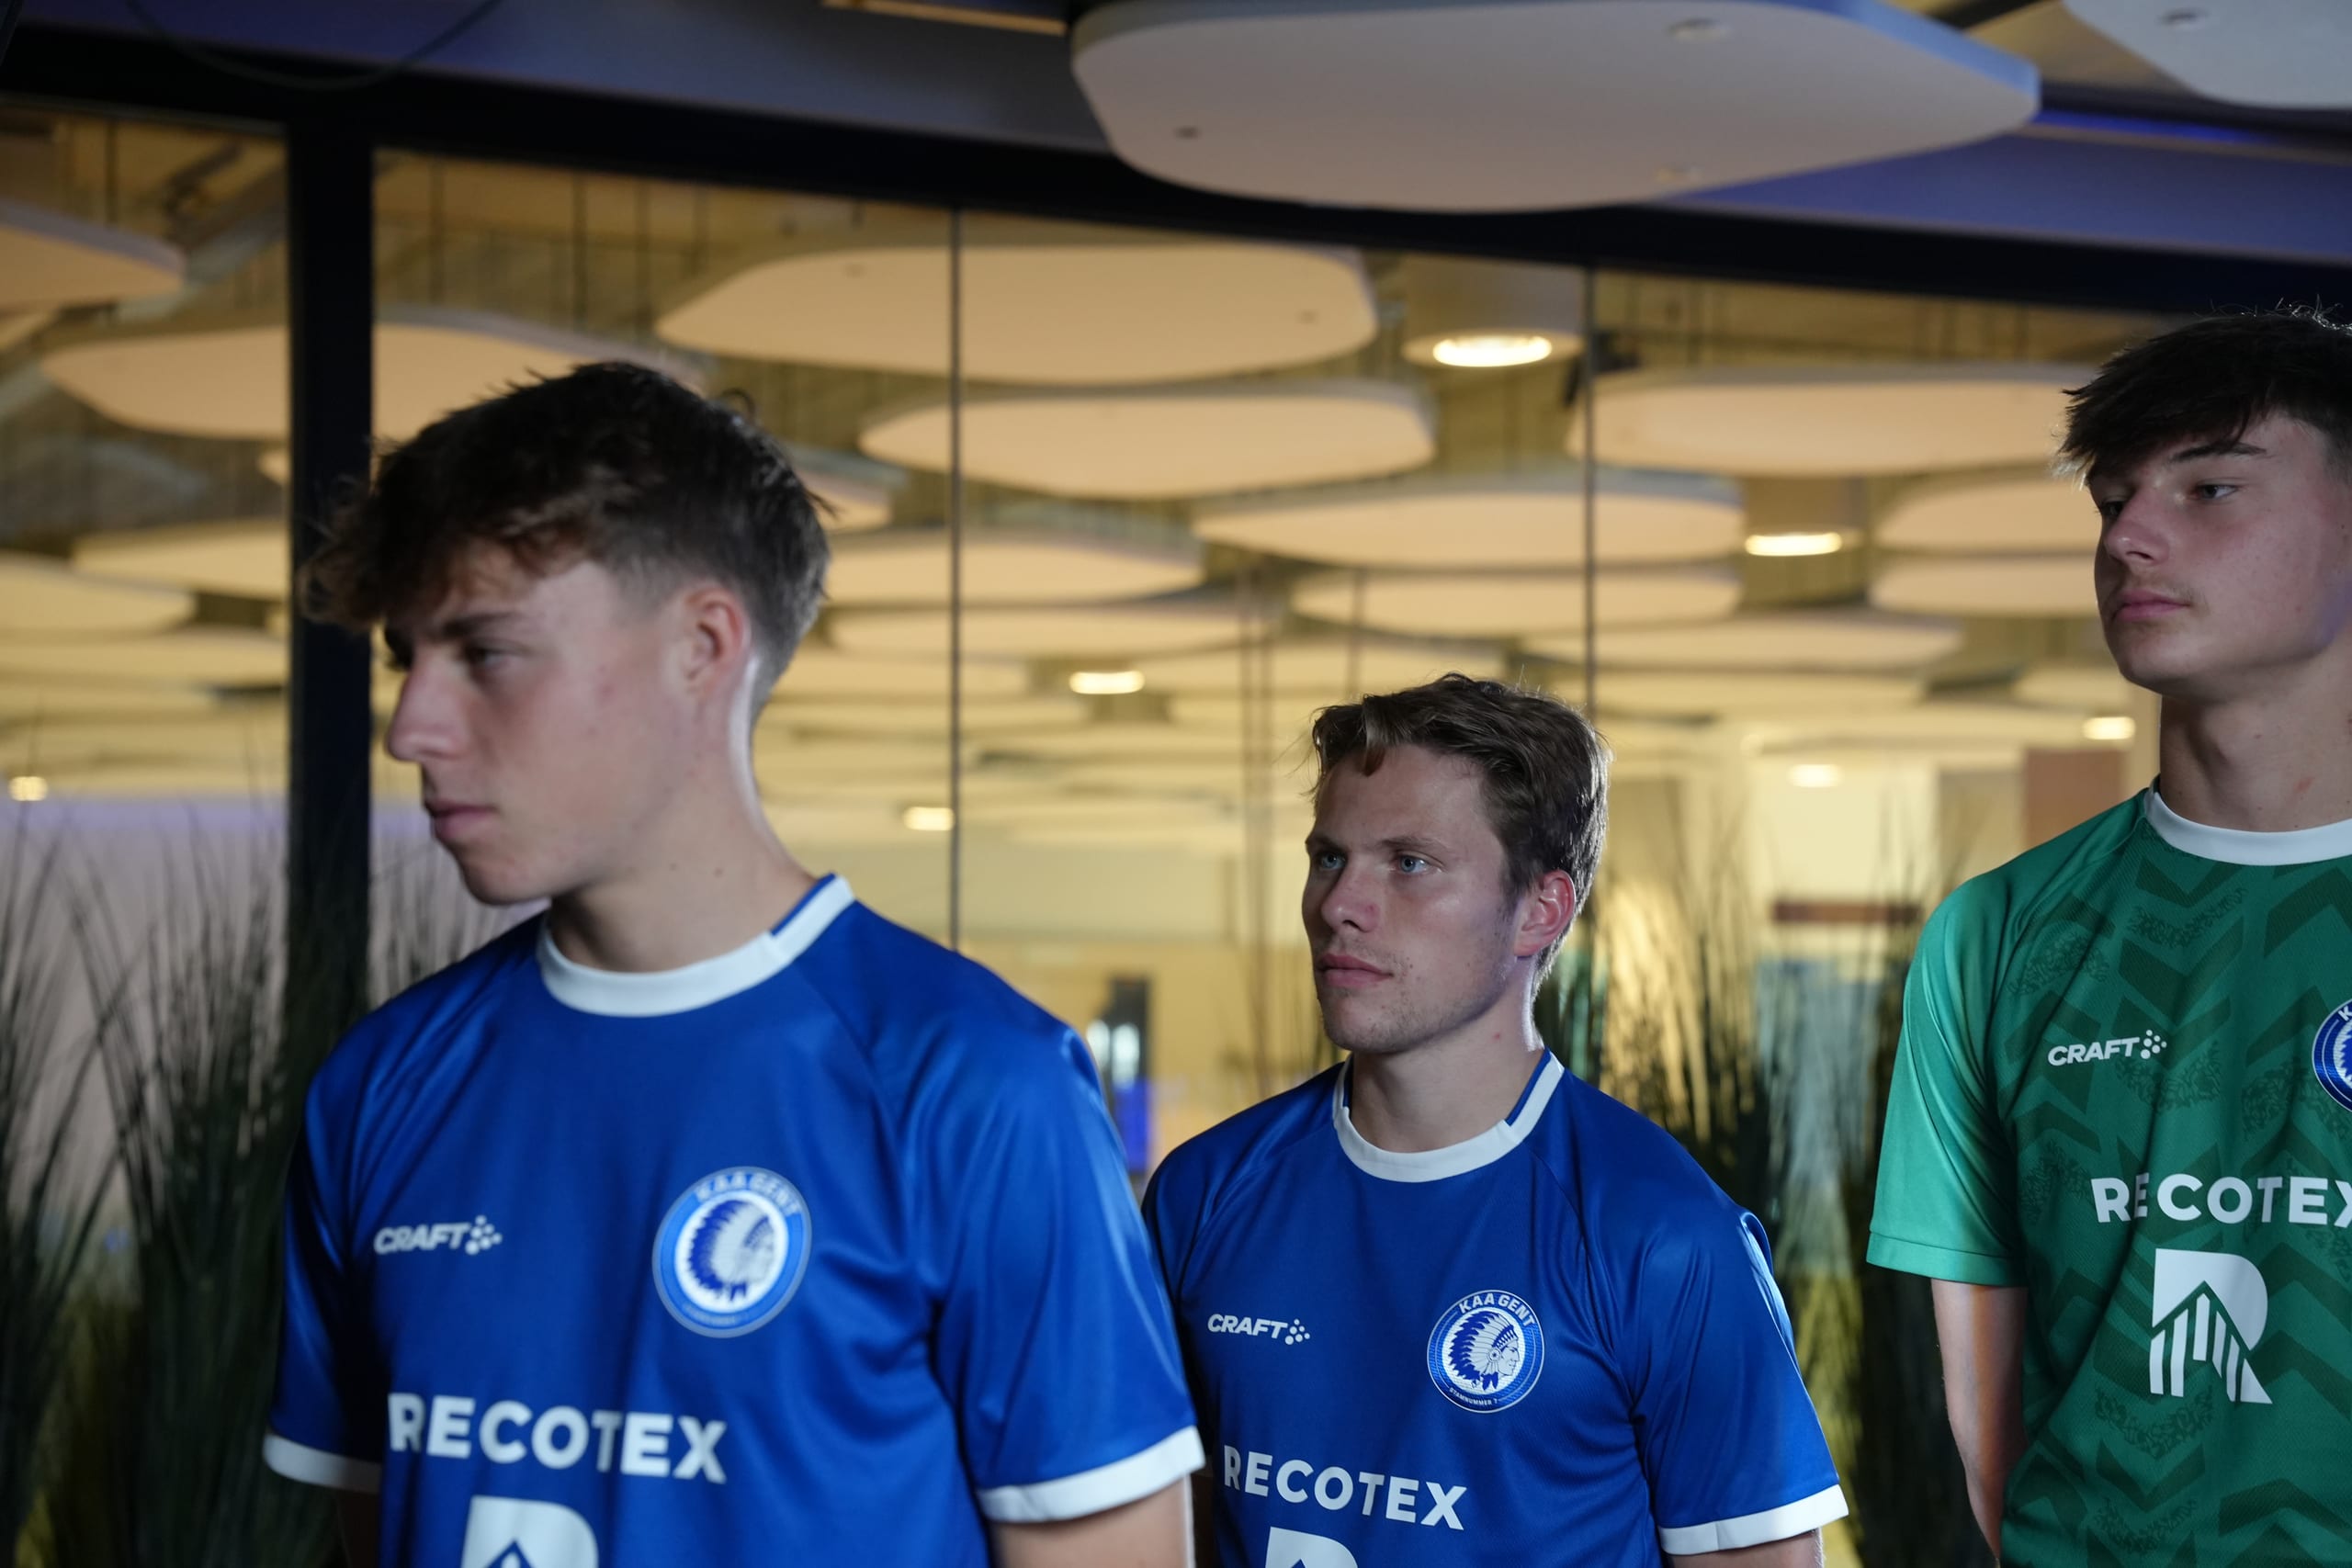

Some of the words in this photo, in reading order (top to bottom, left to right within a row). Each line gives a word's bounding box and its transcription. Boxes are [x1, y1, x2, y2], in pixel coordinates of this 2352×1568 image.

[2048, 1037, 2140, 1066] CRAFT
[374, 1222, 471, 1254] CRAFT
[1498, 1294, 1535, 1326] GENT
[1207, 1314, 1287, 1339] CRAFT
[388, 1393, 727, 1483] RECOTEX
[1224, 1445, 1467, 1530] RECOTEX
